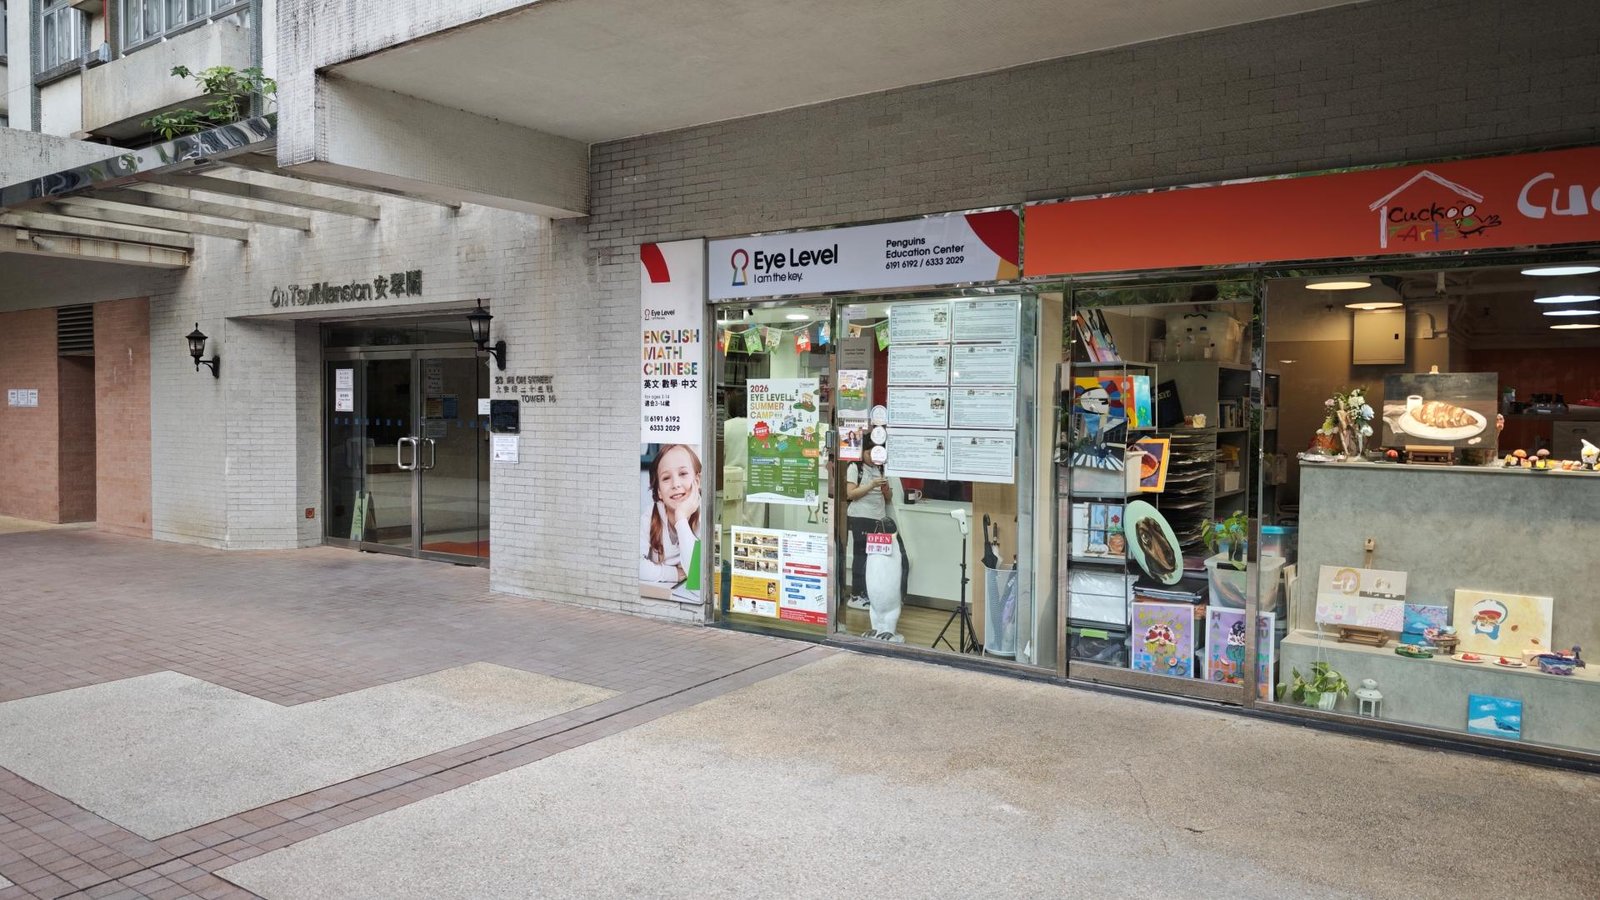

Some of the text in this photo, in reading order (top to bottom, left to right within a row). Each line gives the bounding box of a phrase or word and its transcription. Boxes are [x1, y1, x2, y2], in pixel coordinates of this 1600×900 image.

[886, 236, 926, 248] Penguins
[886, 244, 965, 259] Education Center
[754, 243, 838, 274] Eye Level
[885, 255, 965, 270] 6191 6192 / 6333 2029
[754, 271, 803, 283] I am the key.
[270, 286, 288, 308] On
[316, 280, 372, 304] Mansion
[651, 309, 660, 317] Eye
[643, 329, 700, 344] ENGLISH
[643, 346, 682, 360] MATH
[643, 362, 698, 375] CHINESE
[750, 385, 769, 393] 2026
[521, 395, 545, 403] TOWER
[750, 393, 764, 401] EYE
[750, 402, 785, 411] SUMMER
[750, 411, 774, 419] CAMP
[649, 424, 680, 432] 6333 2029
[868, 534, 891, 543] OPEN
